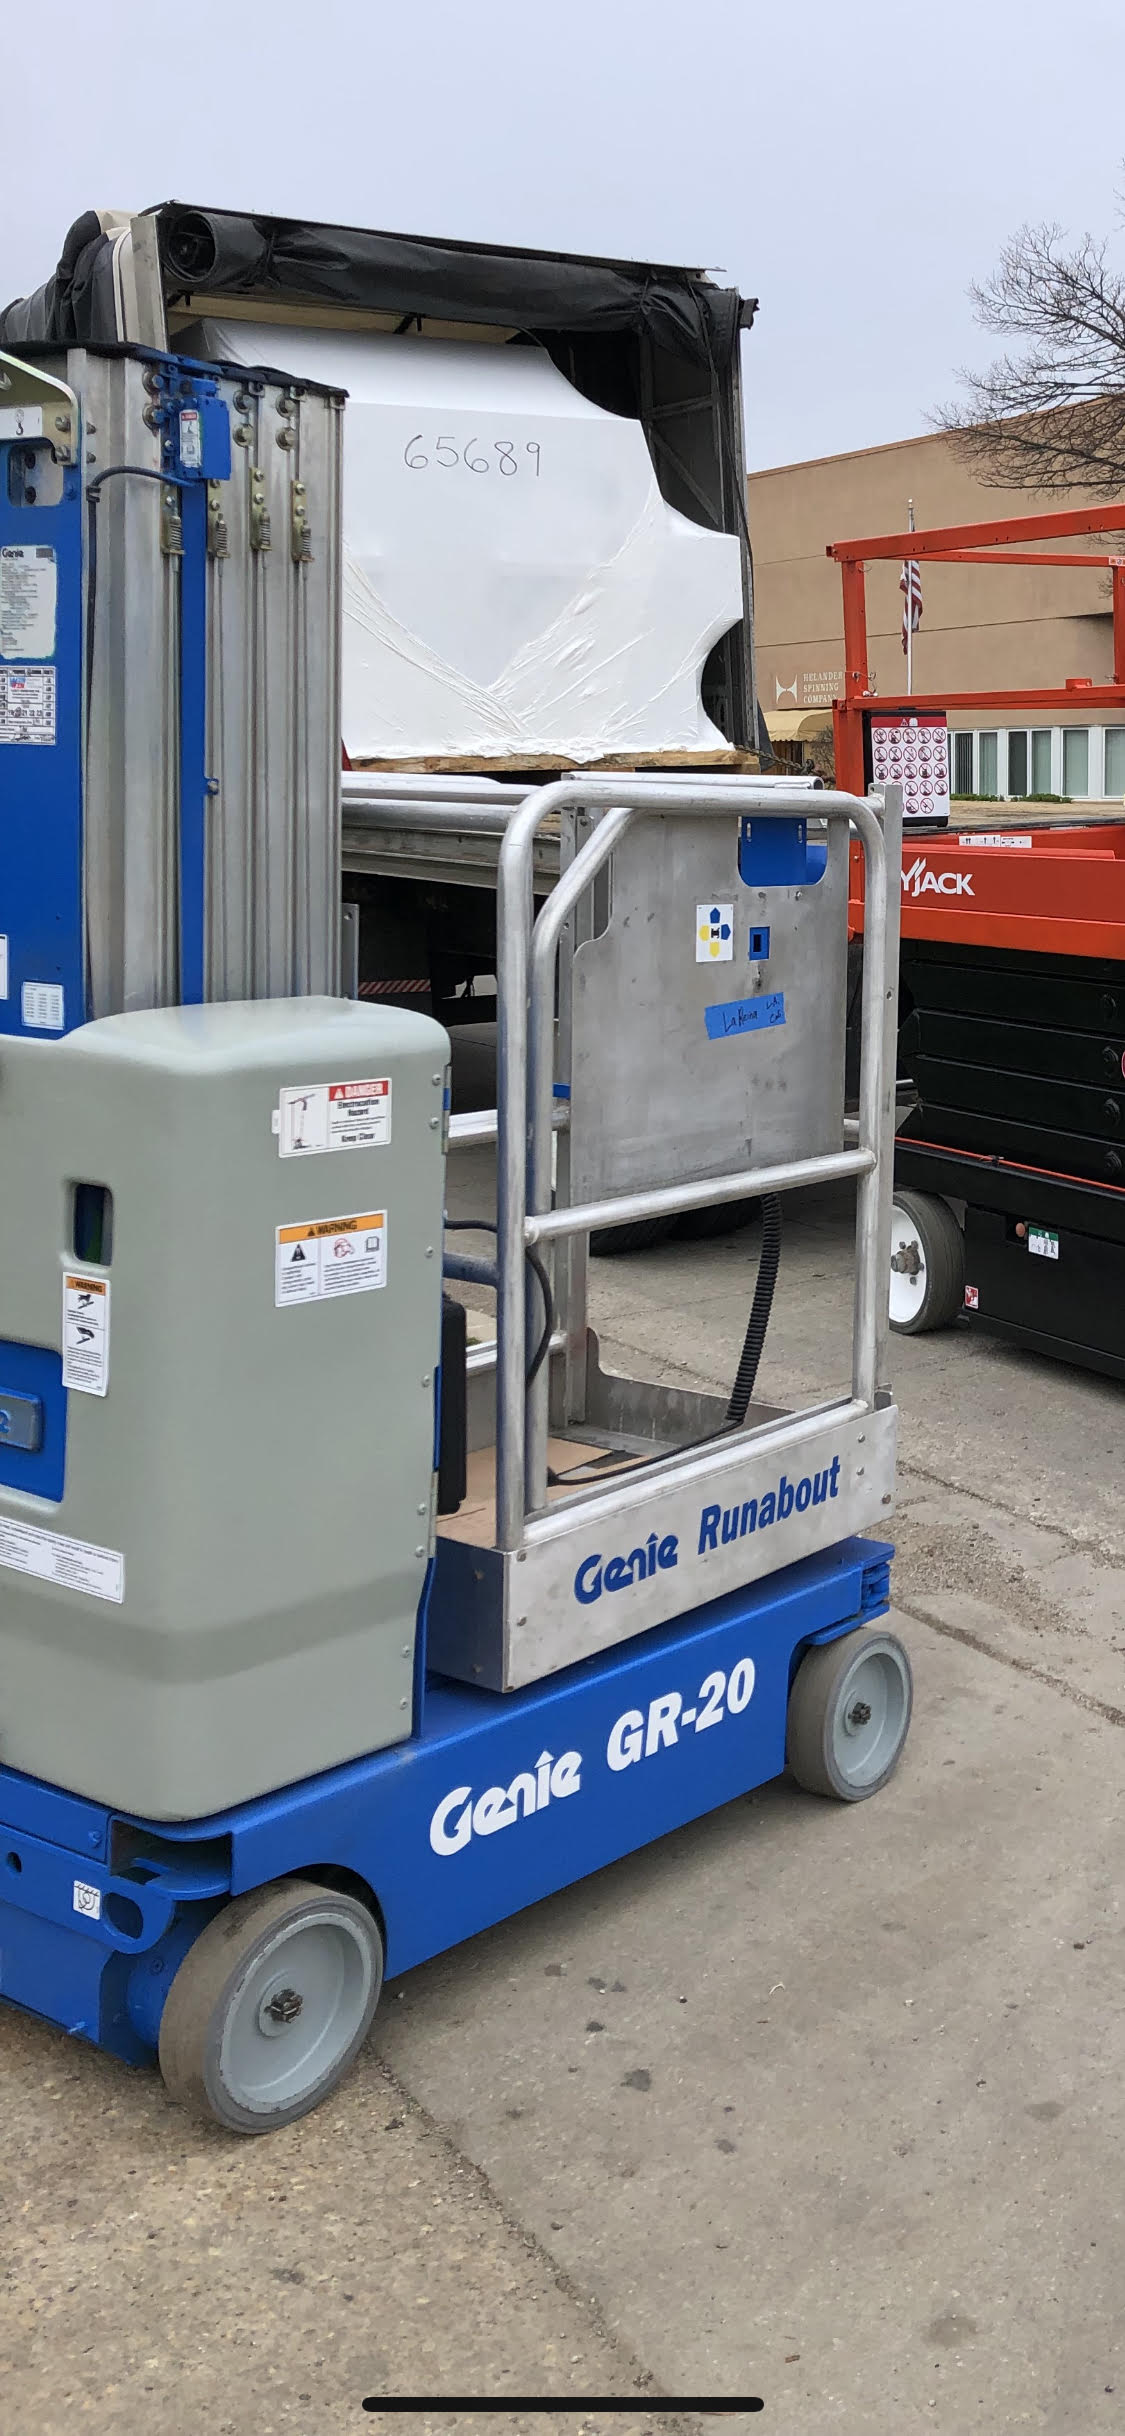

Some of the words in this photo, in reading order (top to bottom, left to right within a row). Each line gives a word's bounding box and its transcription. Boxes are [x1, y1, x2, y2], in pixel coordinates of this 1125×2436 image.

[404, 434, 541, 477] 65689
[803, 671, 843, 682] HELANDER
[803, 682, 839, 693] SPINNING
[344, 1083, 384, 1099] DANGER
[316, 1220, 358, 1236] WARNING
[75, 1281, 103, 1293] WARNING
[574, 1532, 679, 1605] Genie
[697, 1455, 841, 1556] Runabout
[430, 1750, 583, 1856] Genie
[606, 1657, 756, 1772] GR-20
